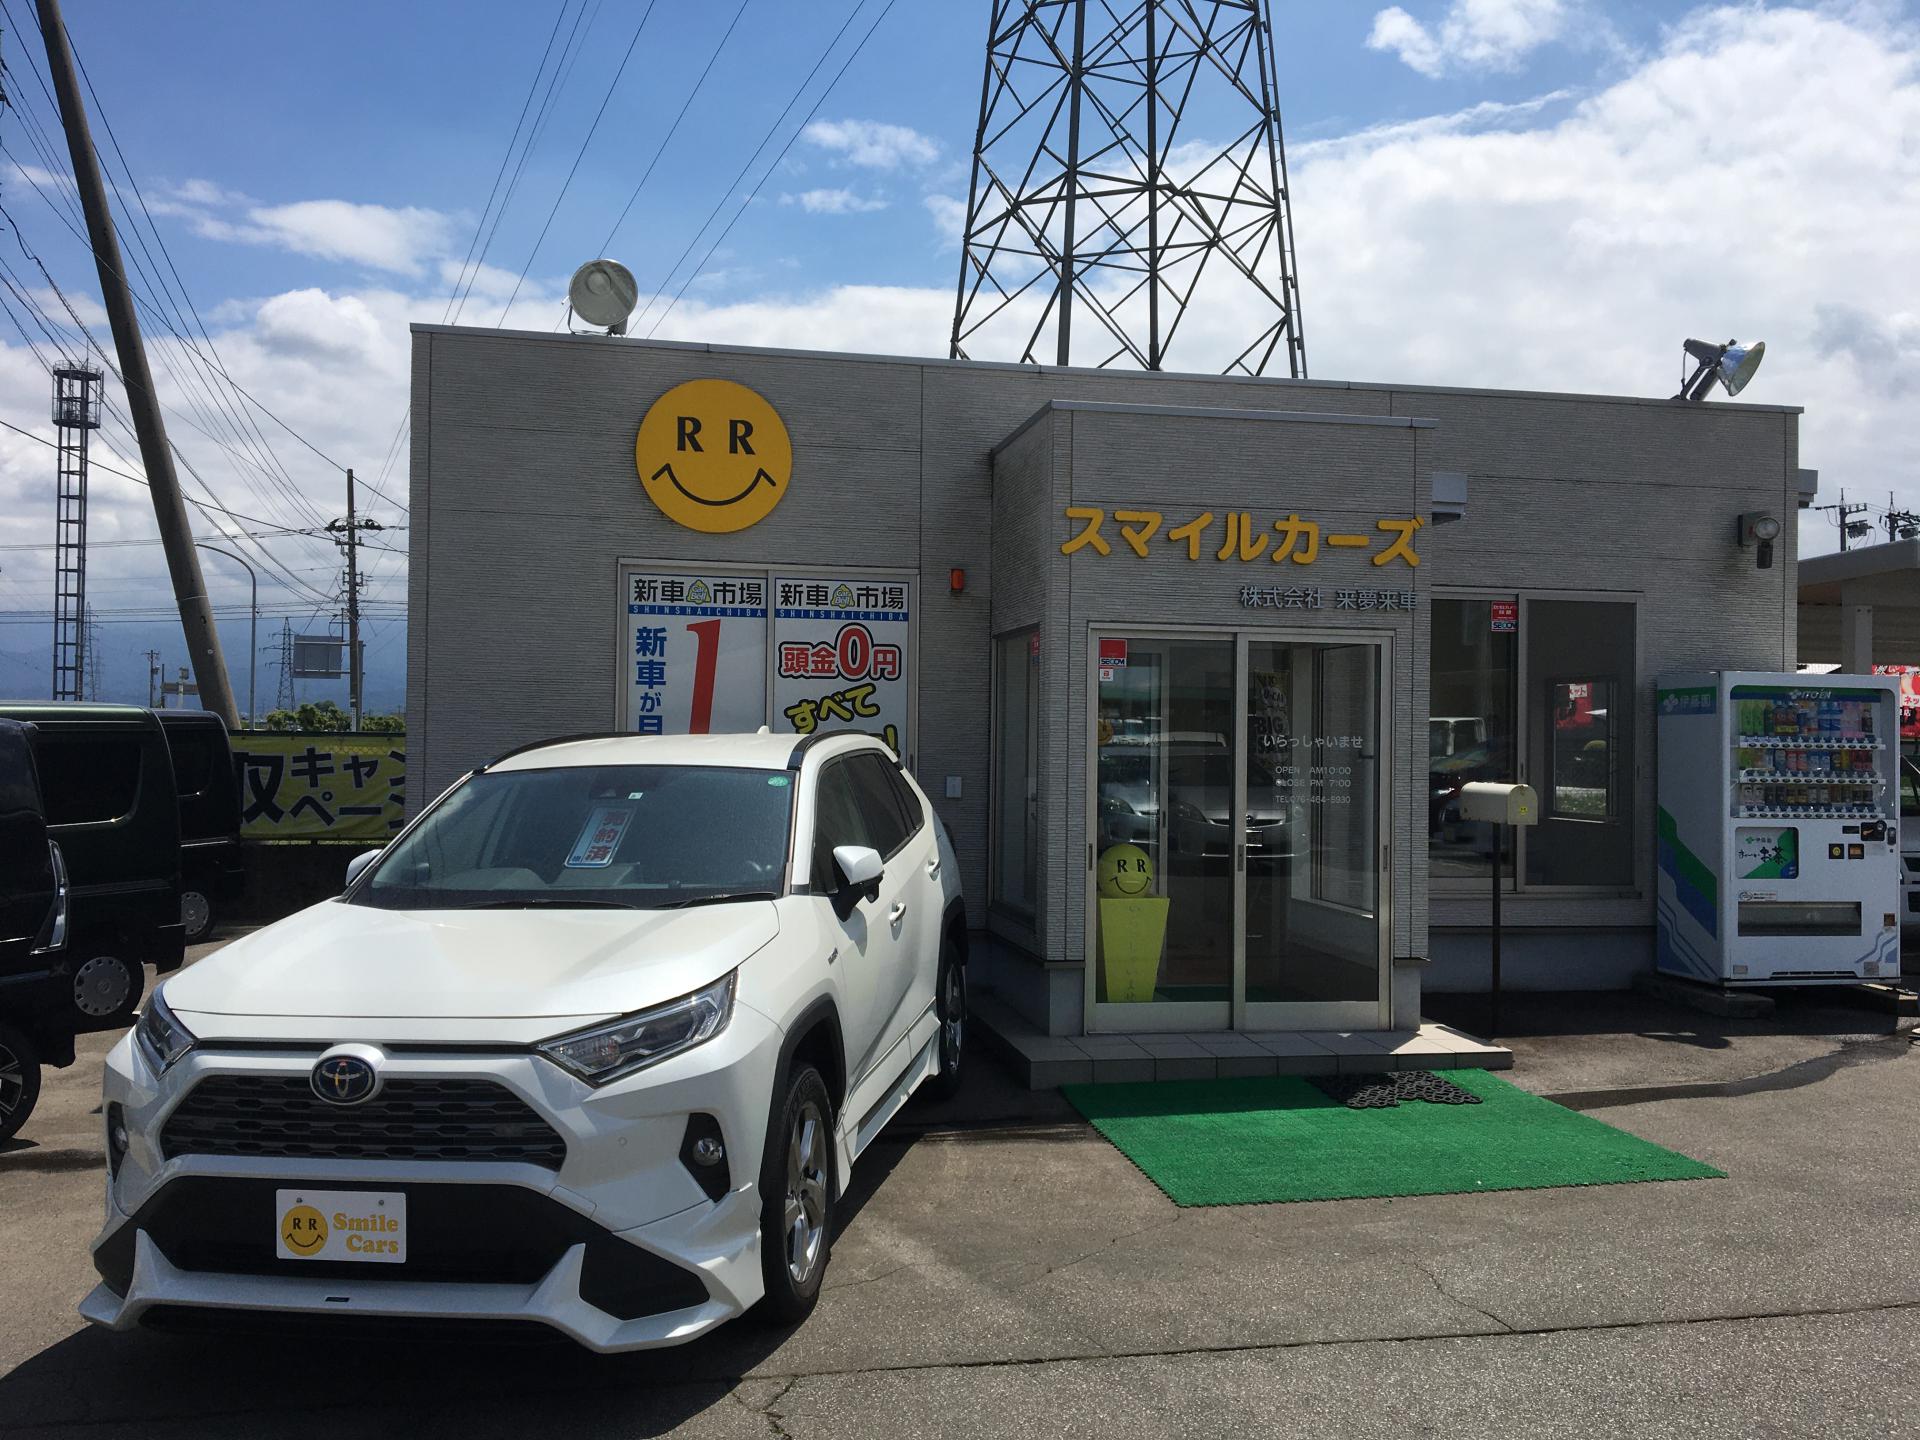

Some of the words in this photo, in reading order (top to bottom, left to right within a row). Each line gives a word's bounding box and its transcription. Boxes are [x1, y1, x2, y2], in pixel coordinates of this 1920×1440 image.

[1061, 506, 1424, 567] スマイルカーズ
[1241, 586, 1324, 609] 株式会社
[1336, 590, 1417, 611] 来夢来車
[633, 605, 762, 617] SHINSHAICHIBA
[779, 610, 904, 621] SHINSHAICHIBA
[781, 624, 899, 679] 頭金0円
[687, 619, 721, 734] 1
[784, 683, 880, 733] すべて
[1263, 734, 1363, 748] いらっしゃいませ
[1275, 766, 1300, 774] OPEN
[1329, 779, 1351, 787] 7:00
[333, 1212, 399, 1233] Smile
[346, 1234, 399, 1254] Cars
